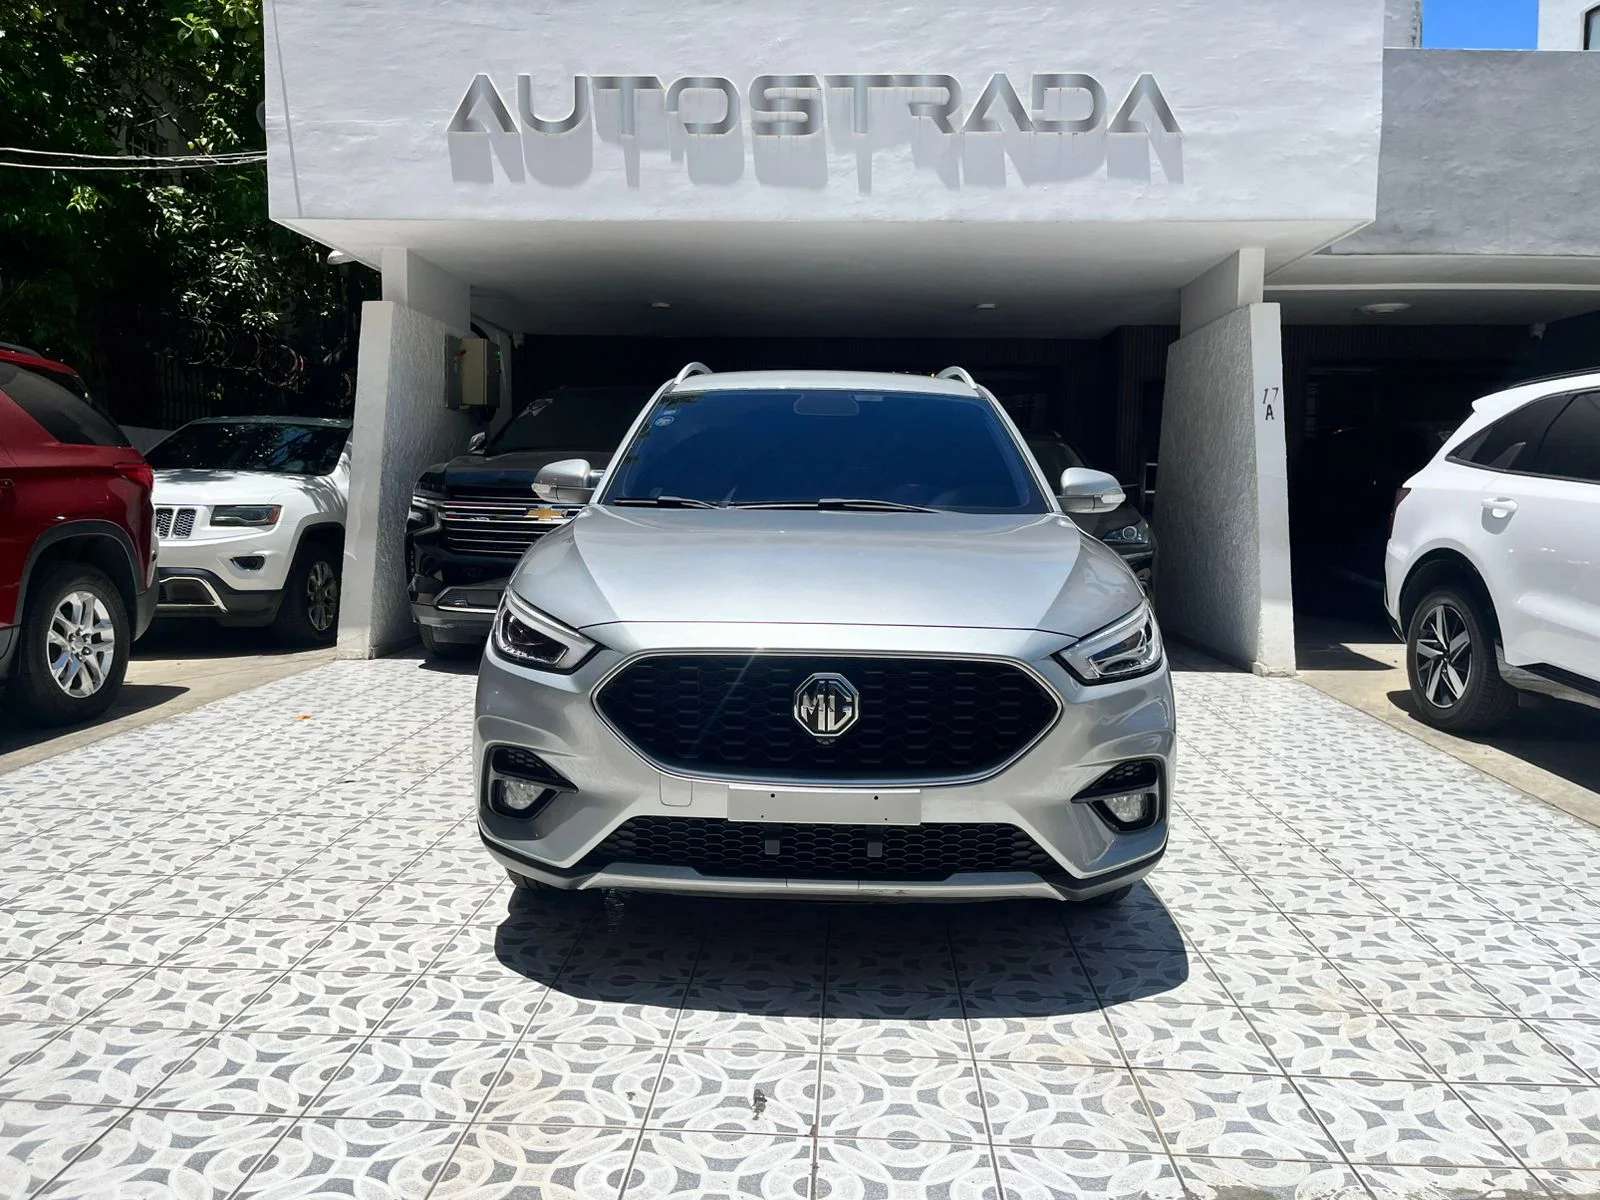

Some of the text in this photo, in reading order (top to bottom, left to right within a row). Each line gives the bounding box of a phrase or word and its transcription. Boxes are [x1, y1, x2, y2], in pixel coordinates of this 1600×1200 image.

[447, 73, 1182, 135] AUTOSTRADA
[1262, 387, 1279, 404] 17
[1265, 404, 1274, 420] A
[800, 680, 852, 731] MG
